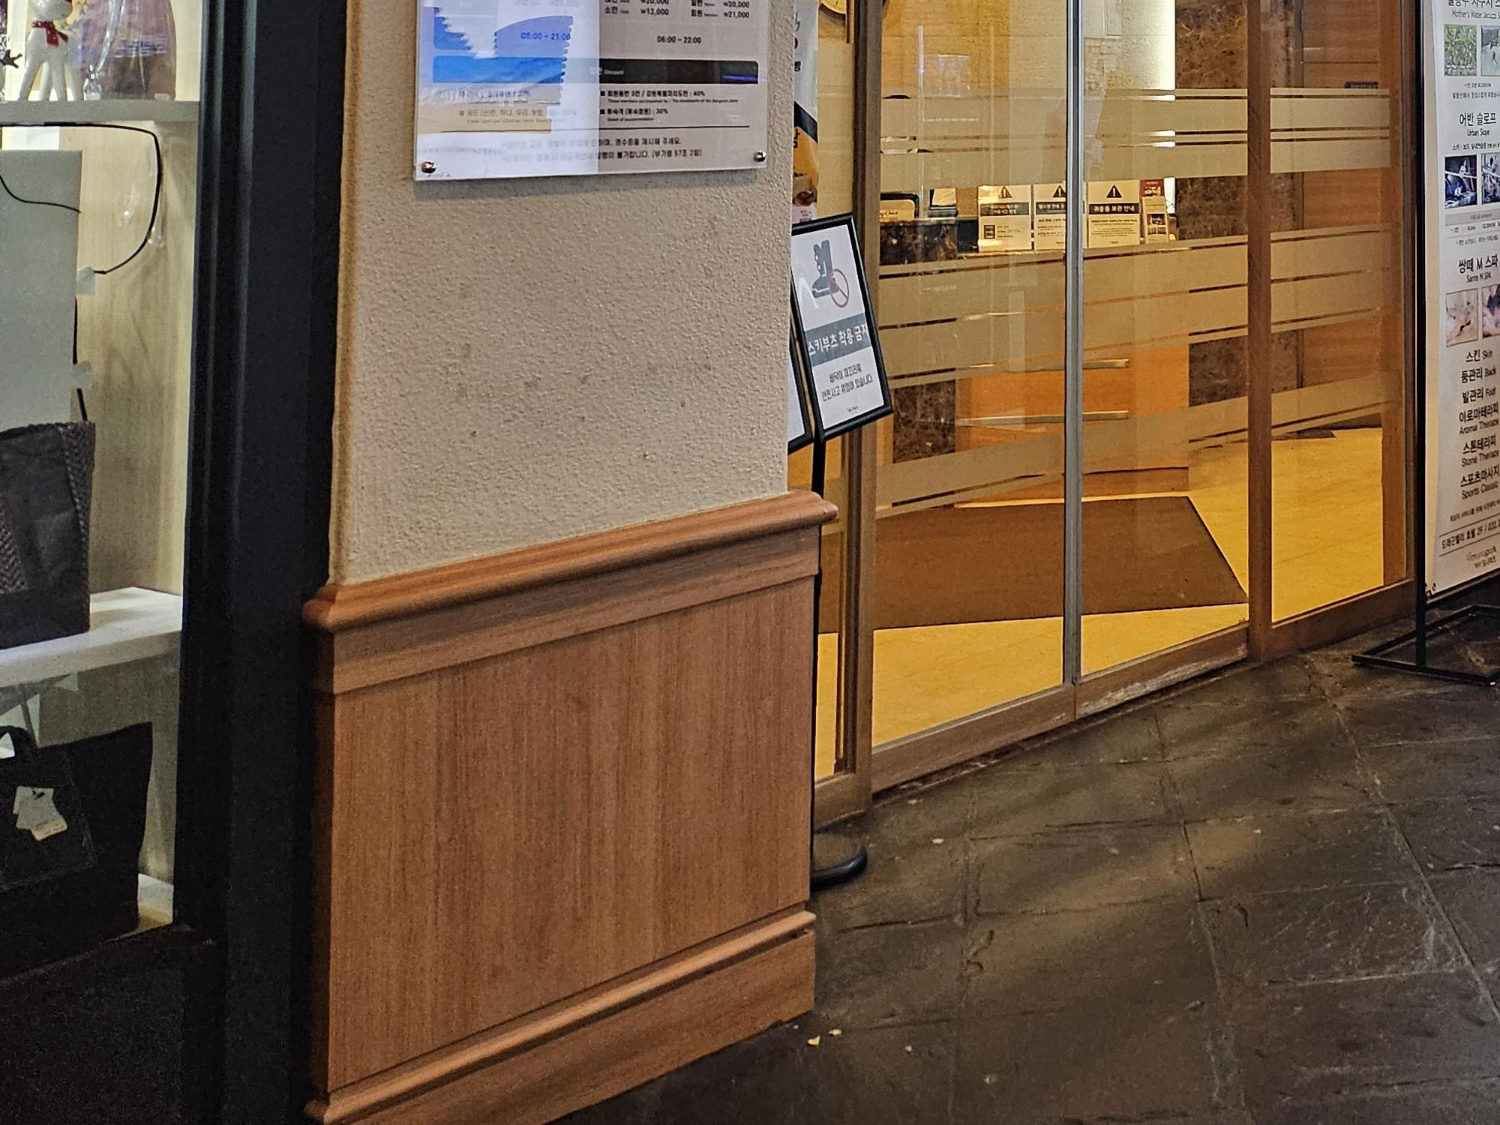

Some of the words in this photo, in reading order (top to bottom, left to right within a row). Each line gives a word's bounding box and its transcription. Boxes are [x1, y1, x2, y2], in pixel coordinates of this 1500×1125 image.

[683, 35, 702, 44] 22:00
[1459, 112, 1474, 127] 어반
[1476, 111, 1497, 127] 슬로프
[1485, 253, 1499, 269] 스파
[808, 334, 839, 355] 스키부츠
[838, 328, 854, 347] 착용
[1466, 349, 1480, 362] 스킨
[1459, 401, 1499, 424] 아로마테라피
